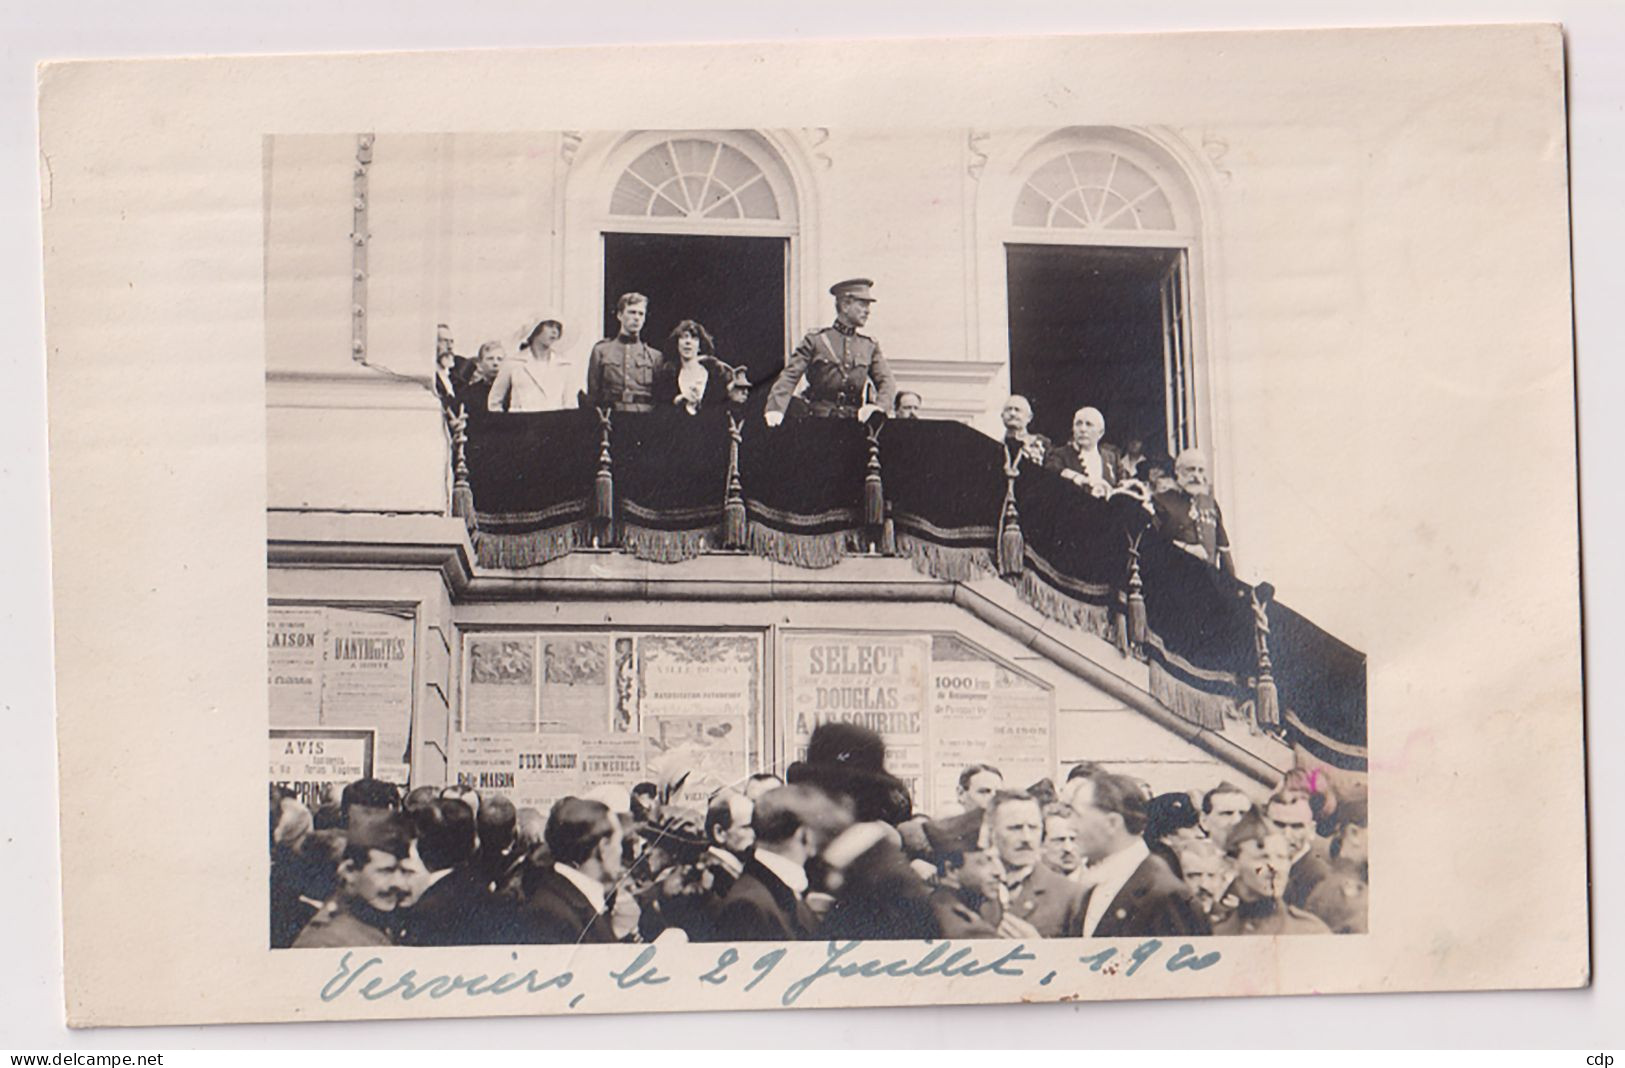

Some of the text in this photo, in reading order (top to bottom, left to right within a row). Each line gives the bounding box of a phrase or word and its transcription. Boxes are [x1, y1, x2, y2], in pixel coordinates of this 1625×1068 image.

[809, 645, 904, 675] SELECT
[935, 676, 973, 689] 1000
[815, 686, 899, 710] DOUGLAS
[796, 711, 809, 735] A
[285, 741, 324, 755] AVIS
[479, 771, 515, 788] MAISON
[321, 951, 586, 1009] Verviers,
[611, 945, 670, 989] le
[700, 947, 787, 991] 29
